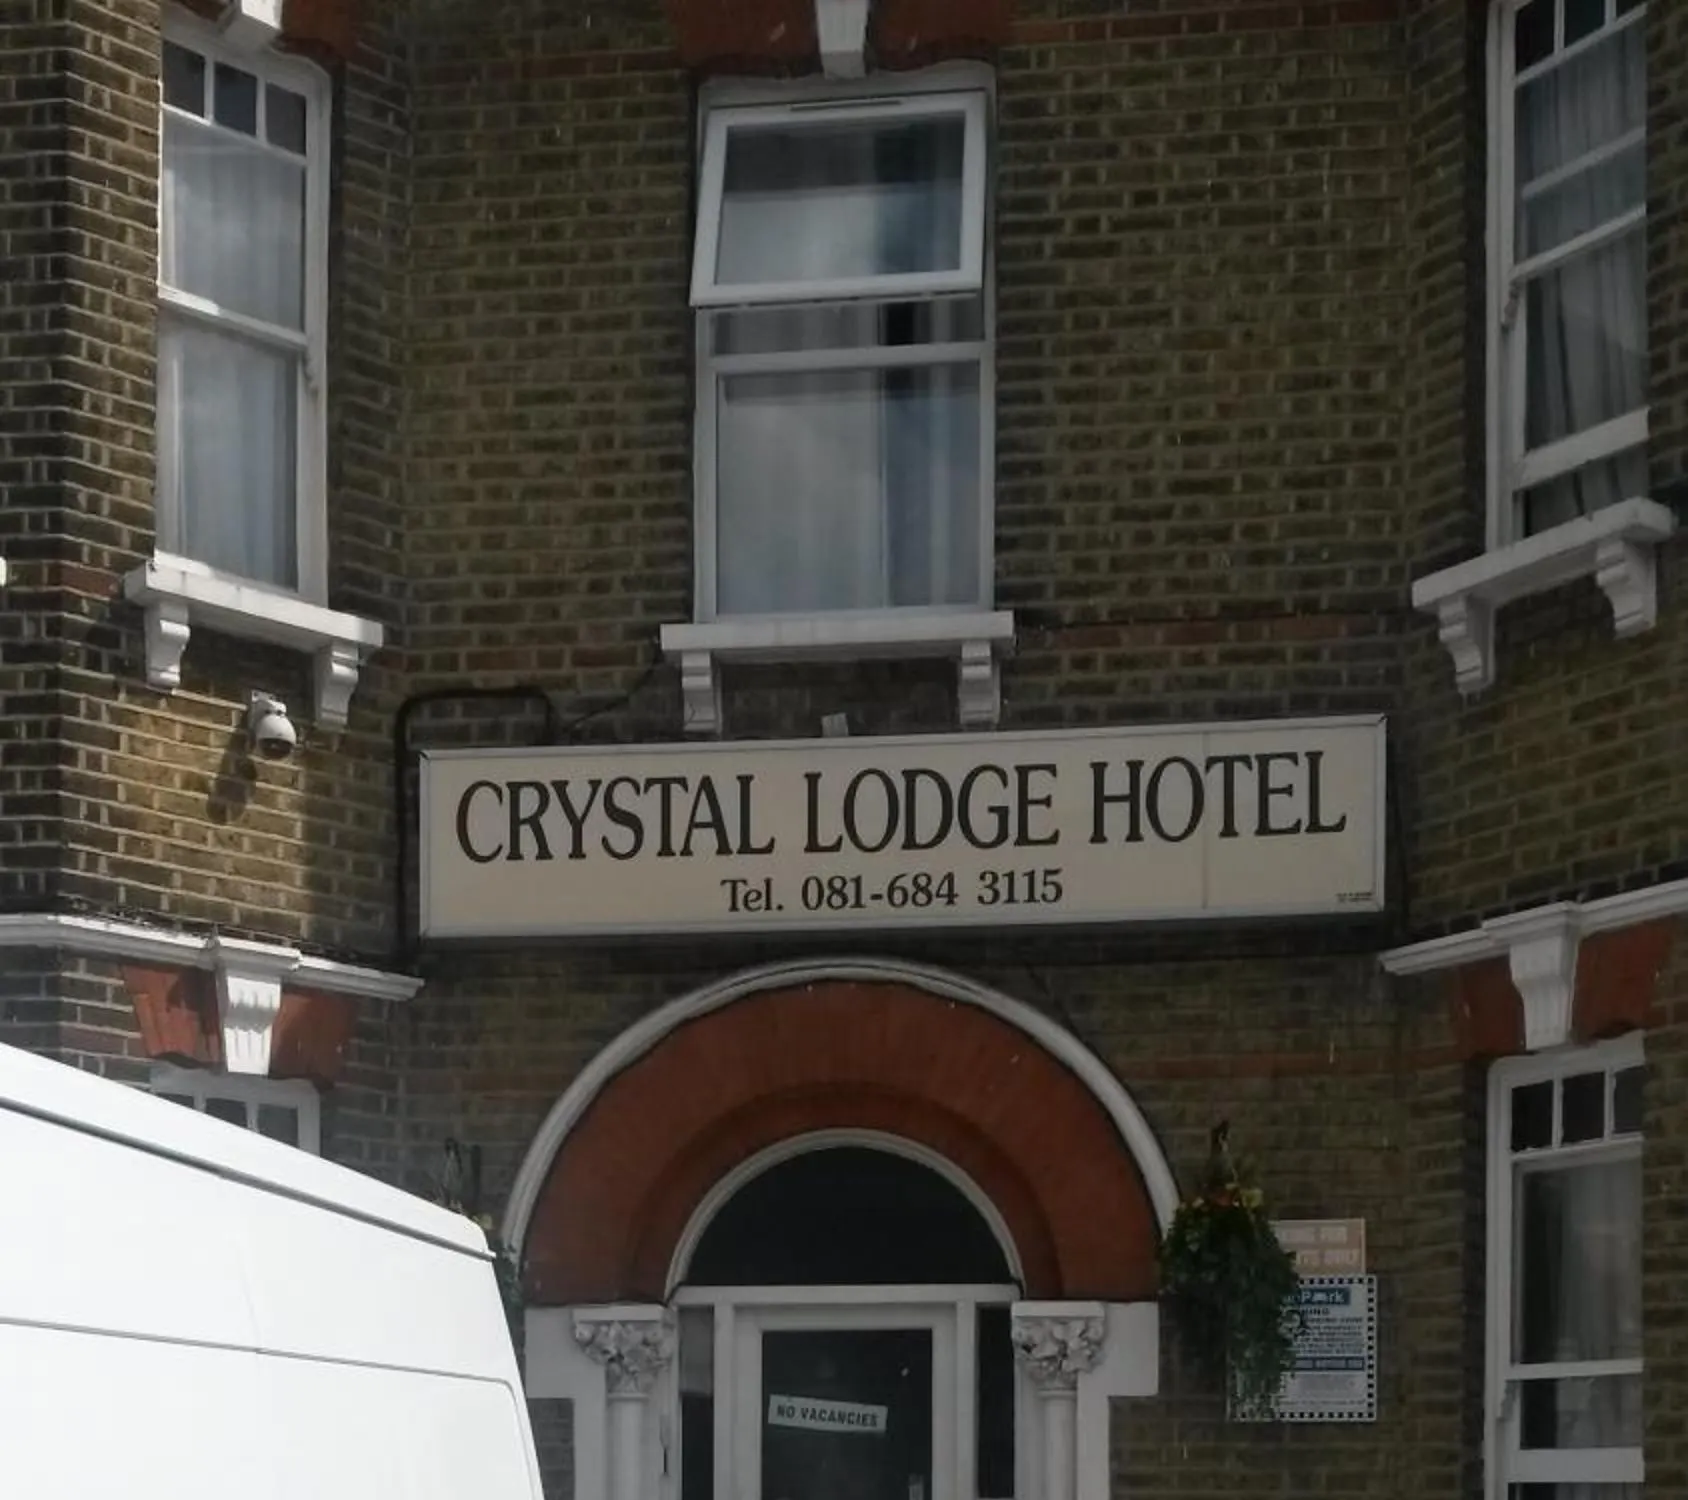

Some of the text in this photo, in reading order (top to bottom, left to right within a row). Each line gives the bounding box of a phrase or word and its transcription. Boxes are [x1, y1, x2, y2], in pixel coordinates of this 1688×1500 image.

[456, 750, 1348, 864] CRYSTAL LODGE HOTEL
[720, 868, 1063, 913] Tel. 081-684 3115
[776, 1403, 880, 1428] NO VACANCIES
